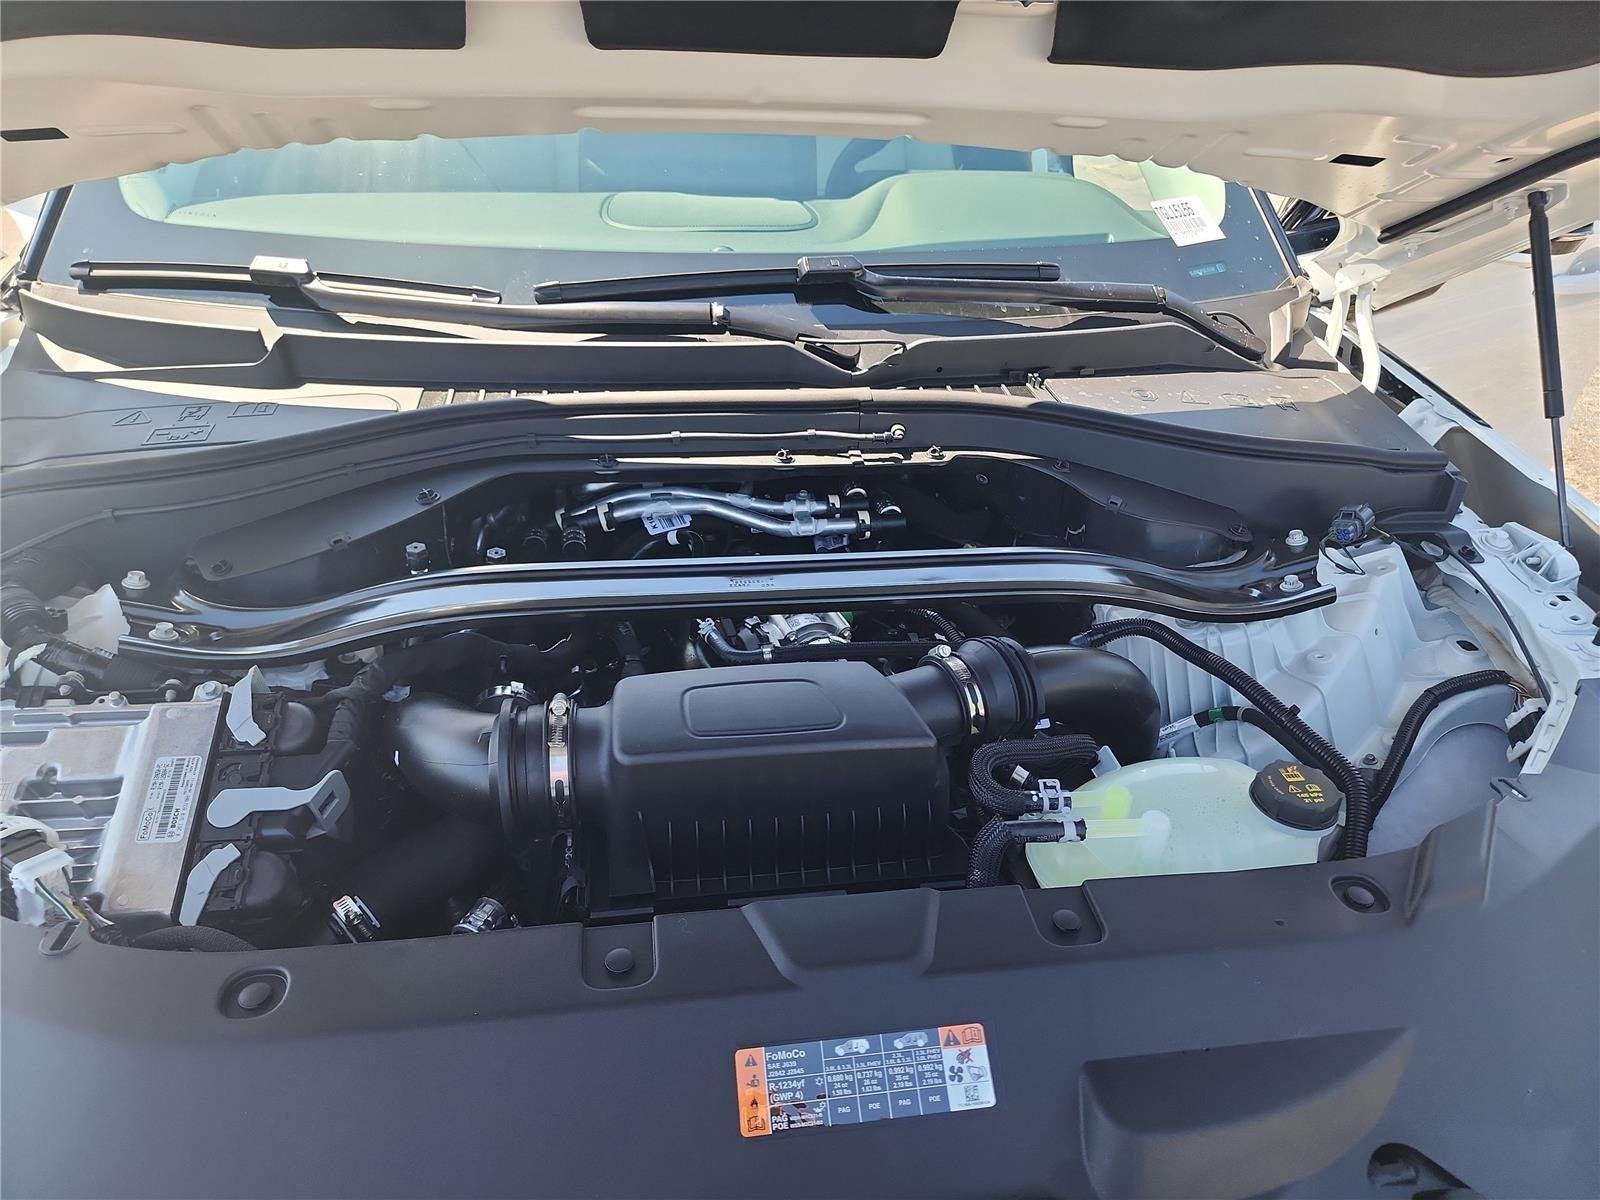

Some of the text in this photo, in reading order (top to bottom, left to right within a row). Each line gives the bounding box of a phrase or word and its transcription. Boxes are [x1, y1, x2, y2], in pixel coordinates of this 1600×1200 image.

[170, 808, 181, 829] BOSCH
[140, 811, 153, 839] FoMoCo
[766, 1048, 806, 1061] FoMoCo
[935, 1063, 943, 1071] kg
[844, 1073, 853, 1082] kg
[769, 1079, 805, 1092] R-1234yf
[770, 1092, 794, 1103] (GWP
[868, 1102, 881, 1110] POE
[772, 1115, 788, 1123] PAG
[772, 1122, 789, 1130] POE
